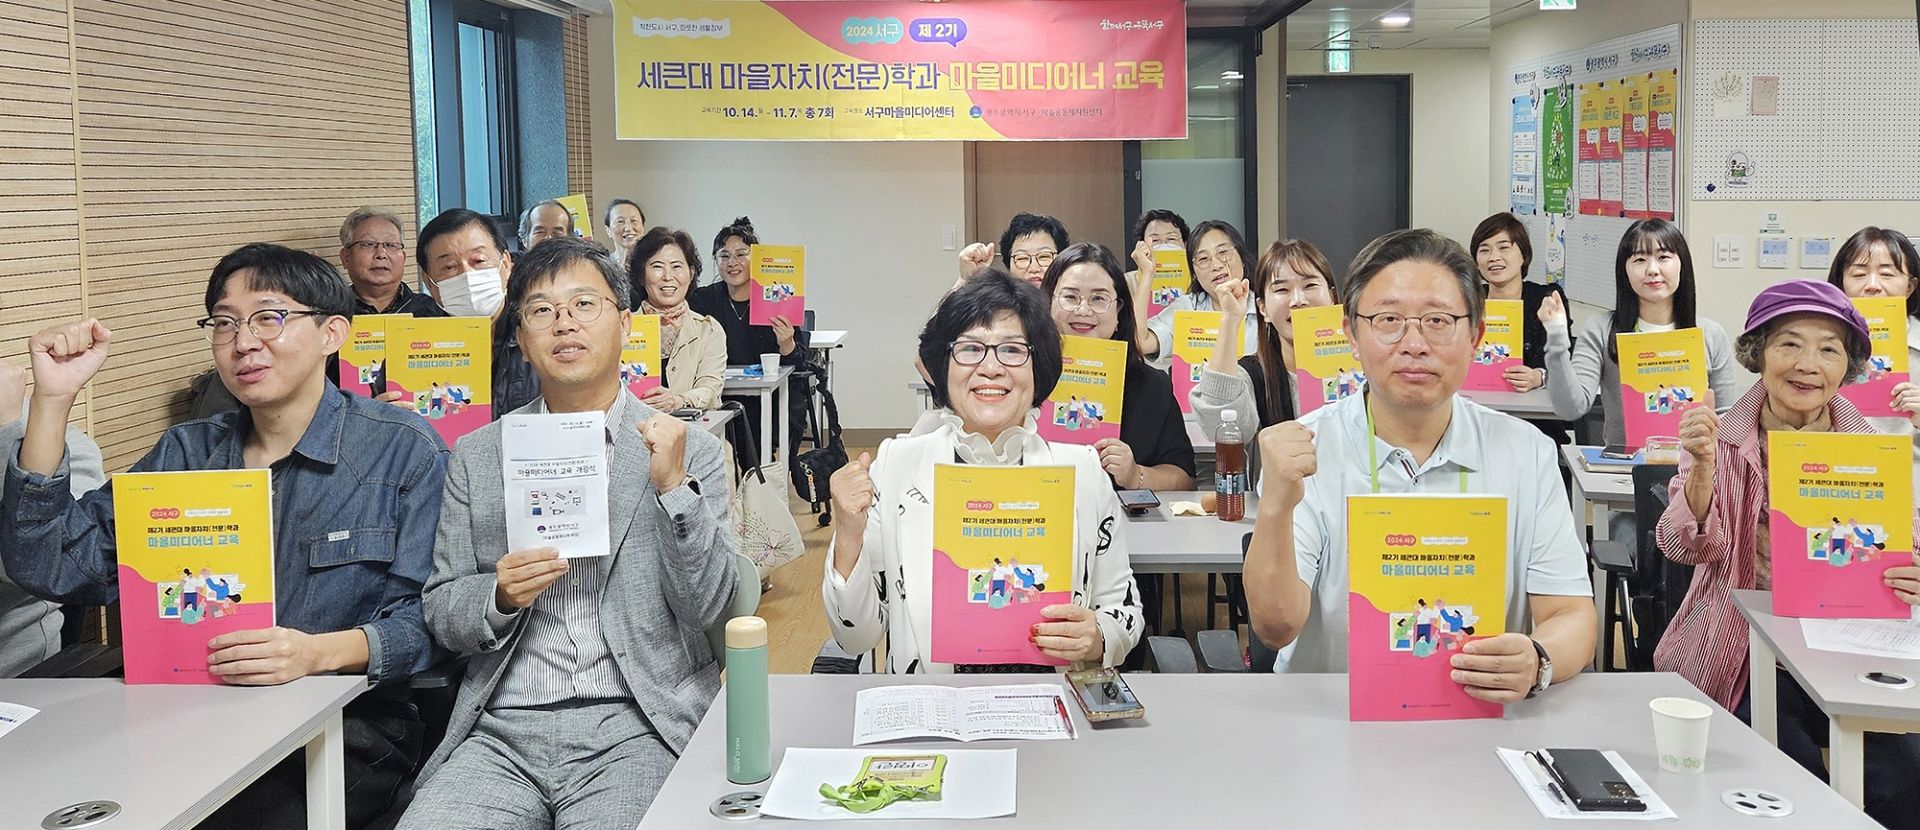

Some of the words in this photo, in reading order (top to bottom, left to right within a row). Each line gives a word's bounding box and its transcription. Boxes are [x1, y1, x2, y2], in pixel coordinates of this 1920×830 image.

[846, 25, 874, 37] 2024
[874, 24, 899, 38] 서구
[918, 23, 932, 38] 제
[934, 23, 958, 38] 2기
[637, 61, 713, 91] 세큰대
[719, 61, 941, 91] 마을자치(전문)학과
[948, 60, 1105, 92] 마을미디어너
[1111, 59, 1165, 91] 교육
[805, 107, 816, 119] 총
[817, 107, 834, 119] 7회
[864, 106, 955, 119] 서구마을미디어센터
[1799, 487, 1861, 499] 마을미디어너
[1864, 489, 1884, 500] 교육
[147, 526, 164, 534] 제2기
[962, 526, 1023, 537] 마을미디어너
[1026, 526, 1045, 537] 교육
[148, 535, 214, 548] 마을미디어너
[217, 533, 239, 545] 교육
[1381, 563, 1450, 576] 마을미디어너
[1453, 563, 1476, 576] 교육
